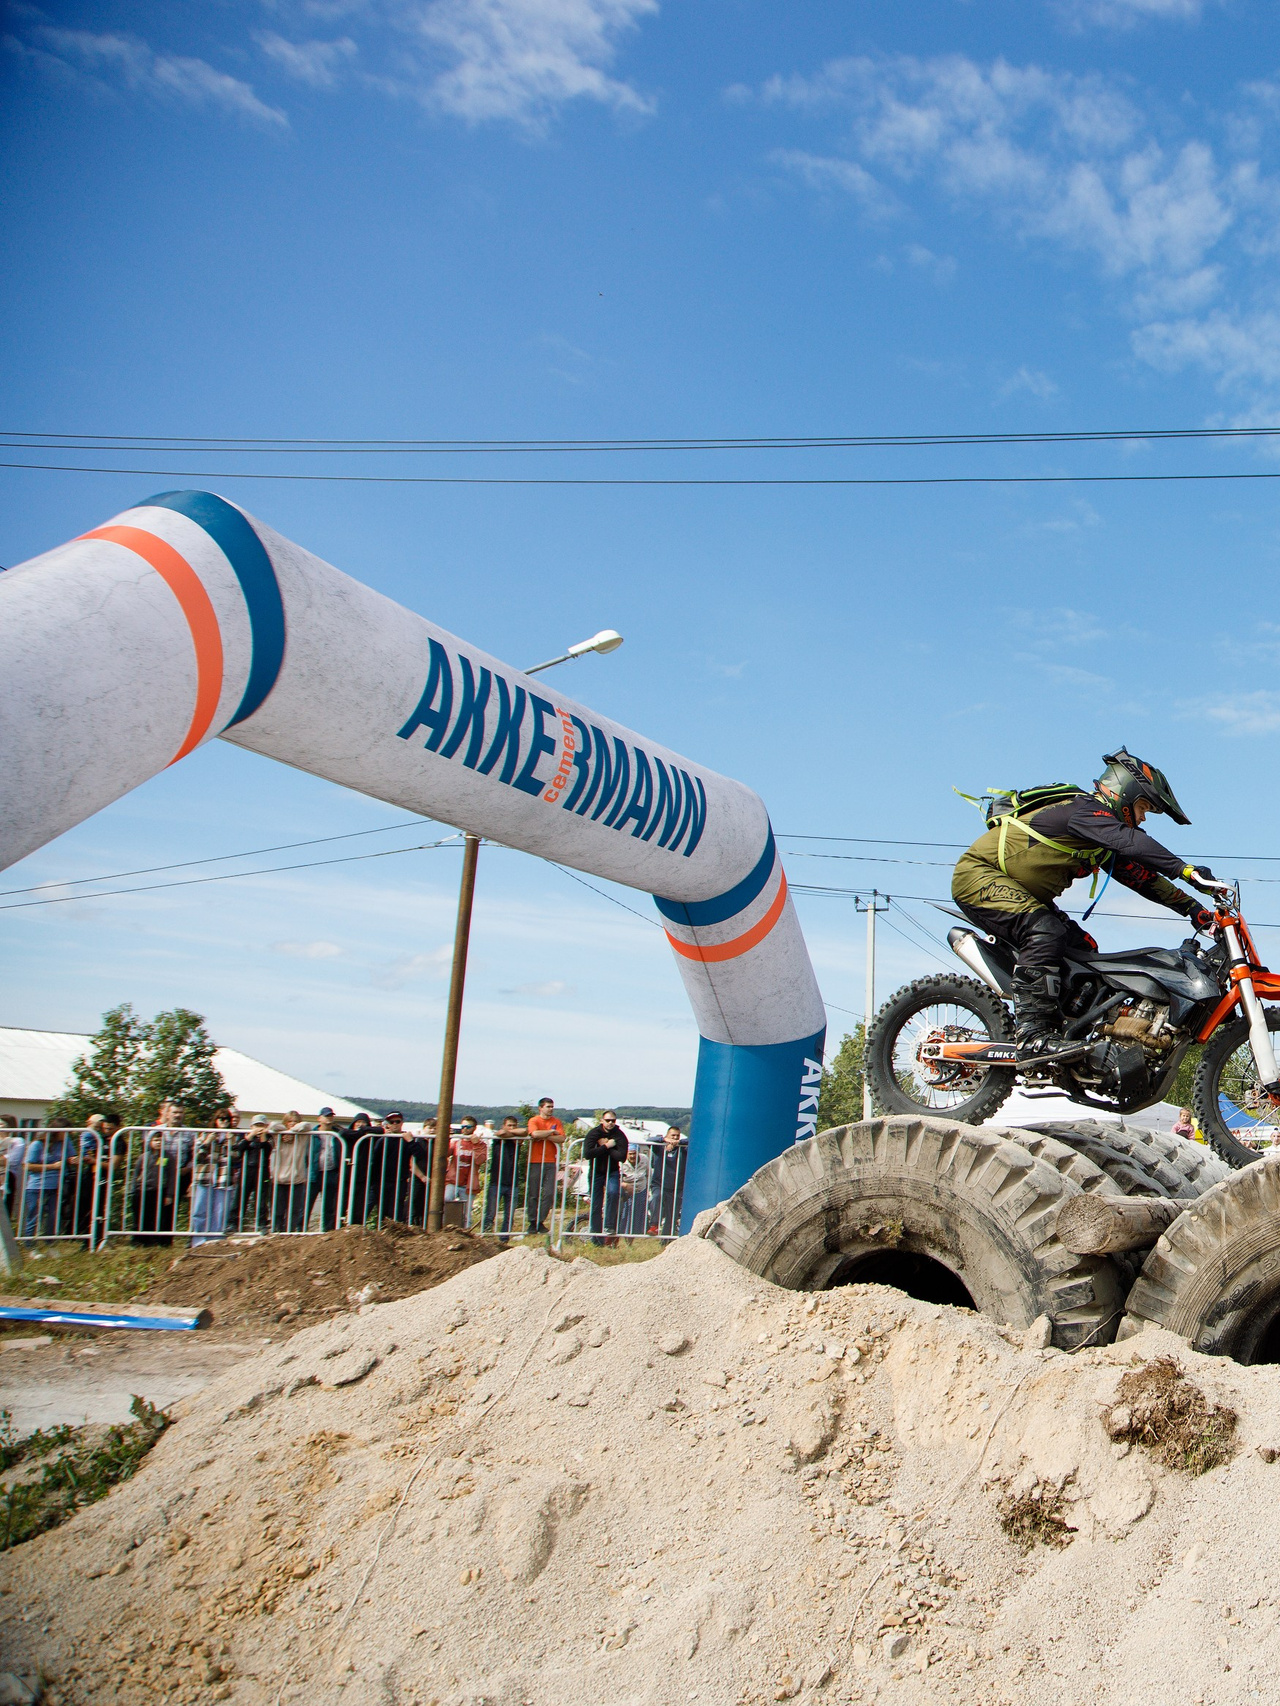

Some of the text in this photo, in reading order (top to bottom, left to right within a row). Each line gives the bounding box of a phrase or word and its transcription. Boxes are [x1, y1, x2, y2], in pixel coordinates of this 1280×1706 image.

[396, 637, 707, 858] AKKERMANN
[543, 707, 576, 804] cement
[794, 1057, 823, 1146] AKK
